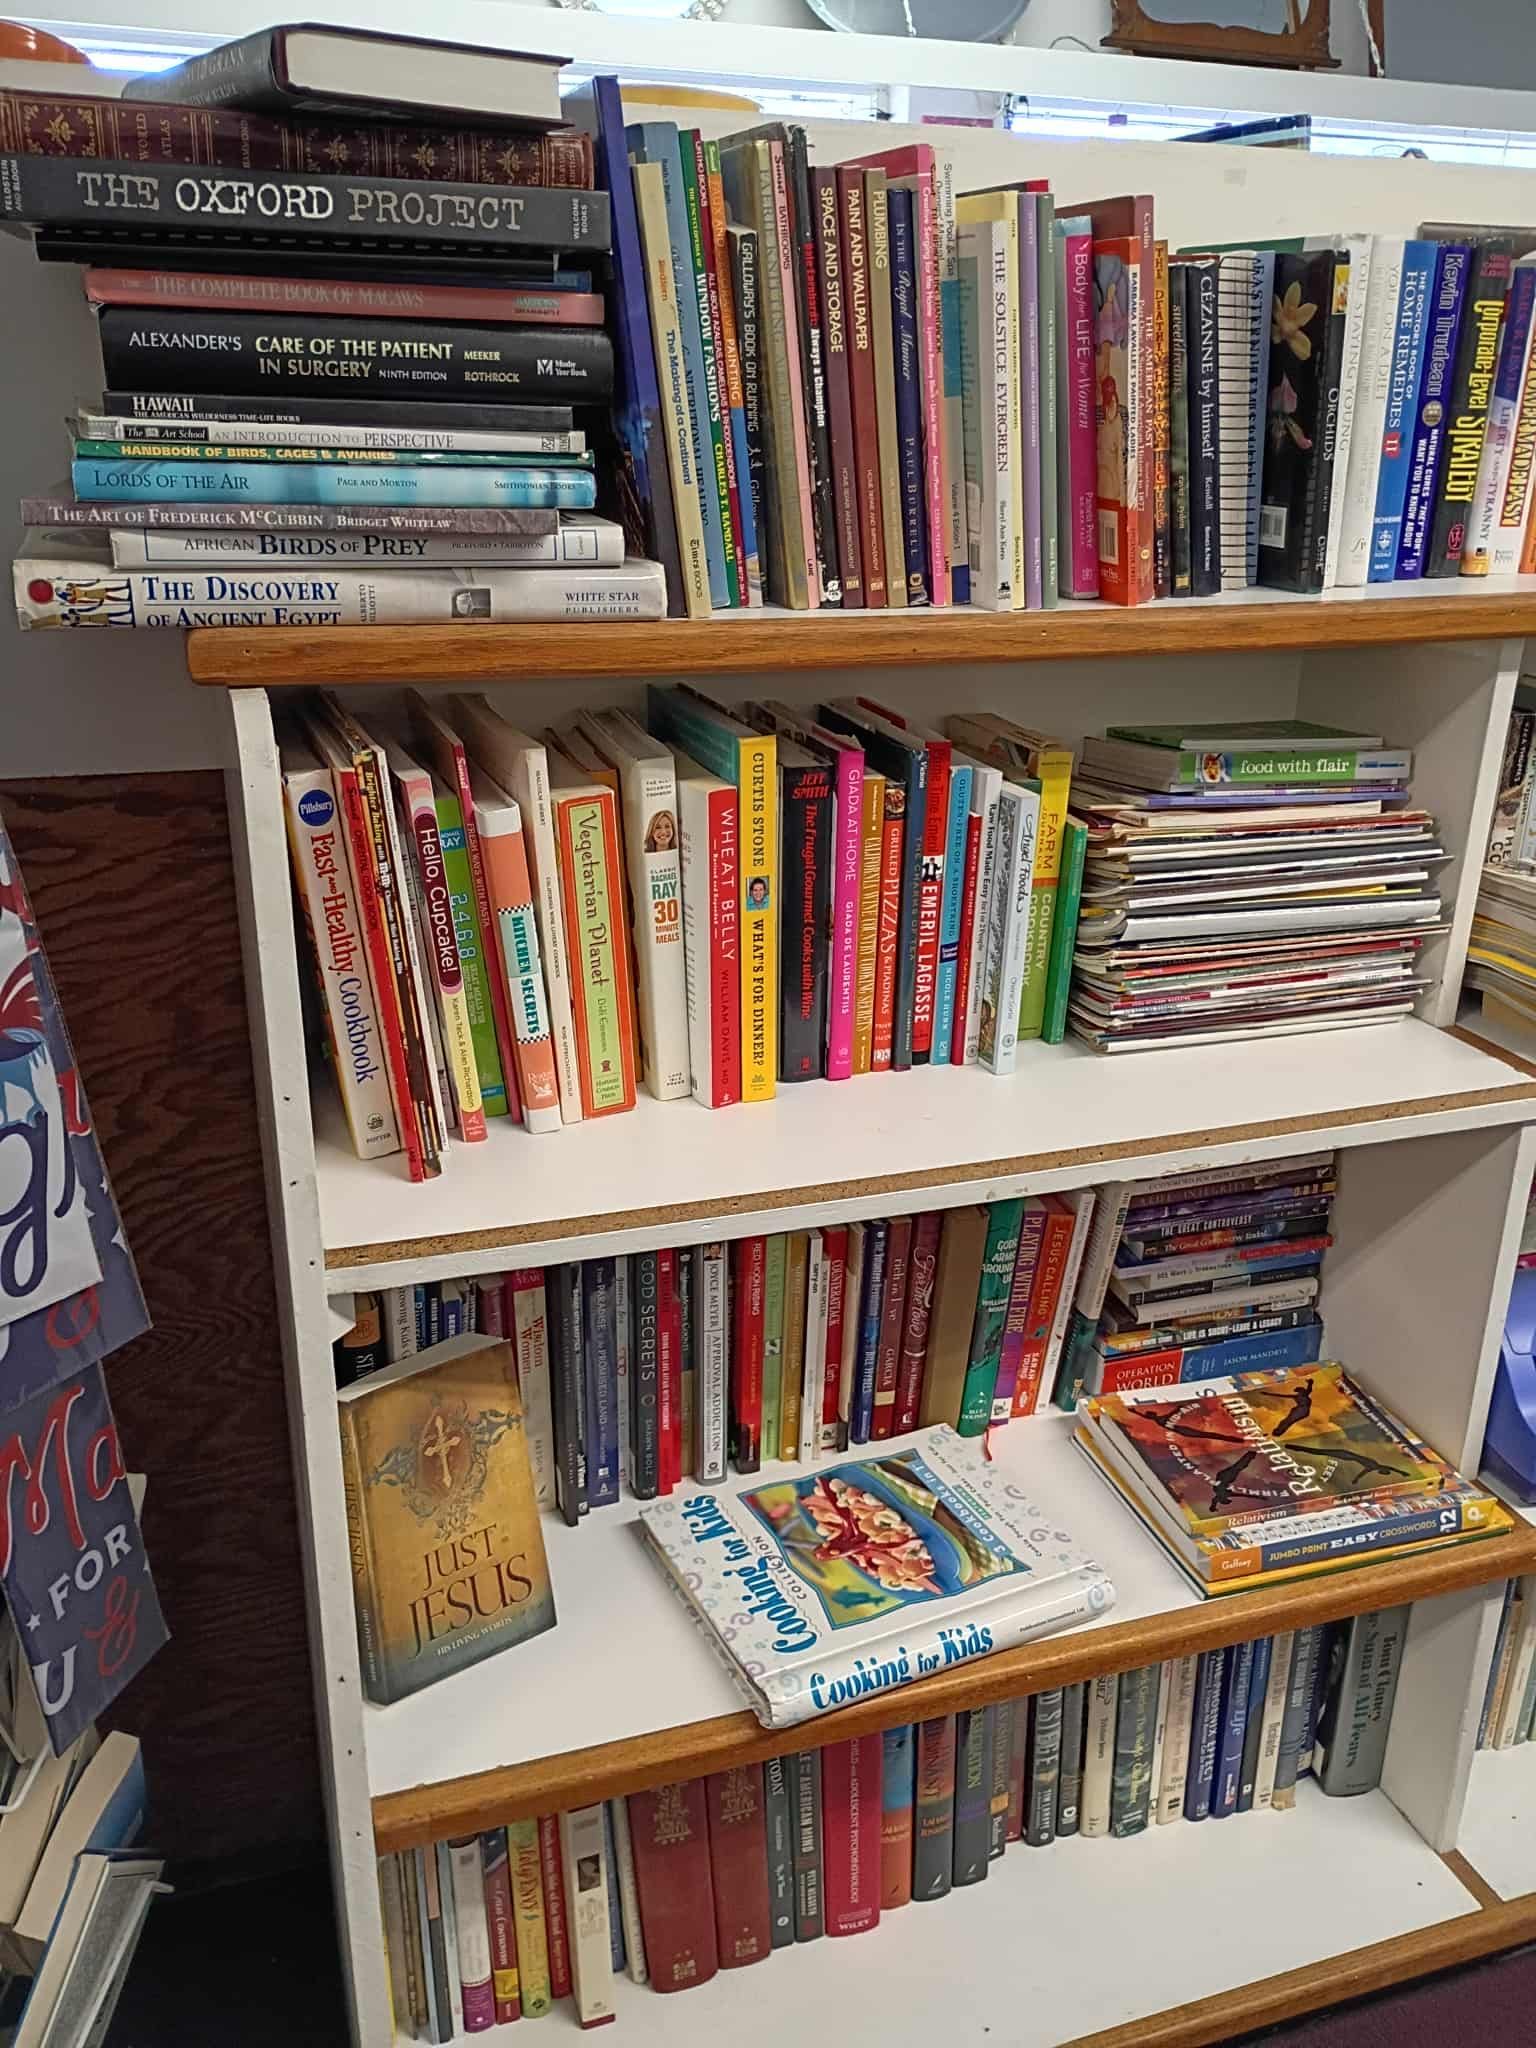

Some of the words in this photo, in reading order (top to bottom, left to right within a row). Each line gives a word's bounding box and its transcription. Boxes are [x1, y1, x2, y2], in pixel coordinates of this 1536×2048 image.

[77, 172, 160, 210] THE
[175, 178, 333, 219] OXFORD
[347, 188, 524, 230] PROJECT
[820, 187, 837, 238] SPACE
[847, 189, 861, 231] PAINT
[851, 234, 863, 267] AND
[872, 191, 888, 269] PLUMBING
[741, 242, 756, 319] GALLOWAY'S
[825, 244, 837, 278] AND
[994, 248, 1005, 283] THE
[1073, 254, 1089, 295] Body
[1439, 253, 1465, 310] Kevin
[190, 278, 281, 299] COMPLETE
[285, 283, 328, 303] BOOK
[696, 273, 712, 341] WINDOW
[852, 267, 868, 350] WALLPAPER
[1401, 271, 1418, 329] HOME
[743, 324, 757, 357] BOOK
[826, 279, 844, 353] STORAGE
[994, 292, 1007, 374] SOLSTICE
[1075, 319, 1091, 358] LIFE
[129, 332, 242, 351] ALEXANDER'S
[255, 337, 304, 354] CARE
[310, 339, 336, 355] OF
[341, 340, 377, 356] THE
[381, 341, 453, 359] PATIENT
[464, 351, 500, 361] MEEKER
[260, 358, 281, 374] IN
[287, 360, 372, 377] SURGERY
[379, 369, 409, 378] NINTH
[411, 371, 448, 381] EDITION
[464, 371, 520, 383] ROTHROCK
[726, 338, 742, 401] PAINTING
[1405, 349, 1418, 380] BOOK
[1426, 314, 1456, 397] Trudeau
[133, 396, 194, 412] HAWAII
[703, 345, 720, 422] FASHIONS
[1388, 334, 1411, 428] REMEDIES
[746, 381, 760, 432] RUNNING
[996, 383, 1009, 472] EVERGREEN
[1201, 402, 1216, 459] himself
[1323, 388, 1339, 461] ORCHIDS
[121, 445, 201, 457] HANDBOOK
[205, 447, 223, 457] OF
[275, 449, 317, 459] CAGES
[127, 428, 143, 437] The
[161, 428, 176, 438] Art
[178, 430, 206, 439] School
[364, 433, 454, 448] PERSPECTIVE
[1417, 439, 1427, 464] WANT
[94, 471, 151, 488] LORDS
[157, 475, 177, 488] OF
[182, 476, 216, 488] THE
[220, 474, 250, 489] AIR
[1412, 465, 1423, 483] YOU
[49, 507, 85, 522] THE
[88, 507, 122, 522] ART
[124, 511, 145, 522] OF
[149, 508, 235, 525] FREDERICK
[336, 515, 389, 527] BRIDGET
[390, 515, 451, 529] WHITELAW
[1406, 497, 1420, 521] KNOW
[1480, 481, 1498, 540] TYRANNY
[184, 537, 254, 551] AFRICAN
[258, 534, 337, 555] BIRDS
[340, 541, 360, 553] OF
[363, 535, 429, 556] PREY
[142, 577, 195, 601] THE
[205, 576, 340, 602] DISCOVERY
[565, 592, 605, 602] WHITE
[608, 592, 640, 601] STAR
[176, 608, 267, 626] ANCIENT
[272, 608, 342, 626] EGYPT
[565, 605, 640, 614] PUBLISHERS
[752, 752, 765, 813] CURTIS
[800, 772, 827, 786] JEFF
[1239, 758, 1274, 775] food
[1277, 758, 1312, 774] with
[1316, 757, 1350, 774] flair
[299, 799, 333, 817] Pillsbury
[792, 785, 829, 799] SMITH
[847, 769, 861, 815] GIADA
[720, 808, 735, 888] WHEAT
[752, 816, 765, 867] STONE
[801, 829, 817, 870] Frugal
[846, 818, 859, 834] AT
[1045, 814, 1059, 870] FARM
[311, 832, 339, 877] Fast
[420, 828, 441, 883] Hello,
[576, 809, 604, 920] Vegetarian
[844, 838, 857, 882] HOME
[888, 827, 900, 877] GRILLED
[652, 881, 678, 900] RAY
[654, 899, 678, 923] 30
[918, 883, 939, 947] EMERIL
[323, 894, 355, 974] Healthy
[430, 886, 458, 974] Cupcake!
[656, 933, 680, 945] MEALS
[721, 901, 735, 961] BELLY
[880, 878, 900, 954] PIZZAS
[1034, 893, 1052, 970] COUNTRY
[588, 922, 611, 987] Planet
[752, 919, 765, 972] WHAT'S
[802, 926, 815, 962] Cooks
[520, 977, 541, 1035] SECRETS
[752, 977, 764, 1003] FOR
[841, 947, 853, 1016] LAURENTIIS
[914, 954, 934, 1024] LAGASSE
[339, 977, 380, 1084] Cookbook
[752, 1008, 764, 1067] DINNER?
[1018, 1217, 1044, 1266] PLAYING
[1049, 1227, 1065, 1263] JESUS
[641, 1259, 655, 1298] GOD
[710, 1263, 718, 1293] JOYCE
[1011, 1269, 1034, 1307] WITH
[1037, 1268, 1057, 1317] CALLING
[710, 1295, 718, 1328] MEYER
[1006, 1305, 1028, 1334] FIRE
[1183, 1330, 1197, 1341] LIFE
[641, 1305, 656, 1381] SECRETS
[711, 1335, 721, 1393] APPROVAL
[1223, 1353, 1248, 1366] JASON
[1115, 1374, 1174, 1392] WORLD
[1116, 1361, 1175, 1380] OPERATION
[711, 1395, 721, 1452] ADDICTION
[1221, 1397, 1323, 1496] Relativism
[937, 1484, 995, 1543] Cookbooks
[1227, 1509, 1288, 1528] Relativism
[1269, 1548, 1300, 1562] JUMBO
[1302, 1543, 1329, 1557] PRINT
[1330, 1532, 1380, 1550] EASY
[1379, 1520, 1438, 1540] CROSSWORDS
[1439, 1509, 1458, 1534] 12
[48, 1523, 133, 1621] FOR
[423, 1524, 497, 1591] JUST
[681, 1494, 737, 1544] Kids
[730, 1556, 818, 1655] Cooking
[408, 1554, 533, 1660] JESUS
[451, 1631, 480, 1649] LIVING
[481, 1616, 513, 1637] WORDS
[810, 1647, 912, 1710] Cooking
[917, 1652, 940, 1675] for
[938, 1623, 994, 1666] Kids
[769, 1757, 785, 1796] TODAY
[800, 1777, 813, 1826] AMERICAN
